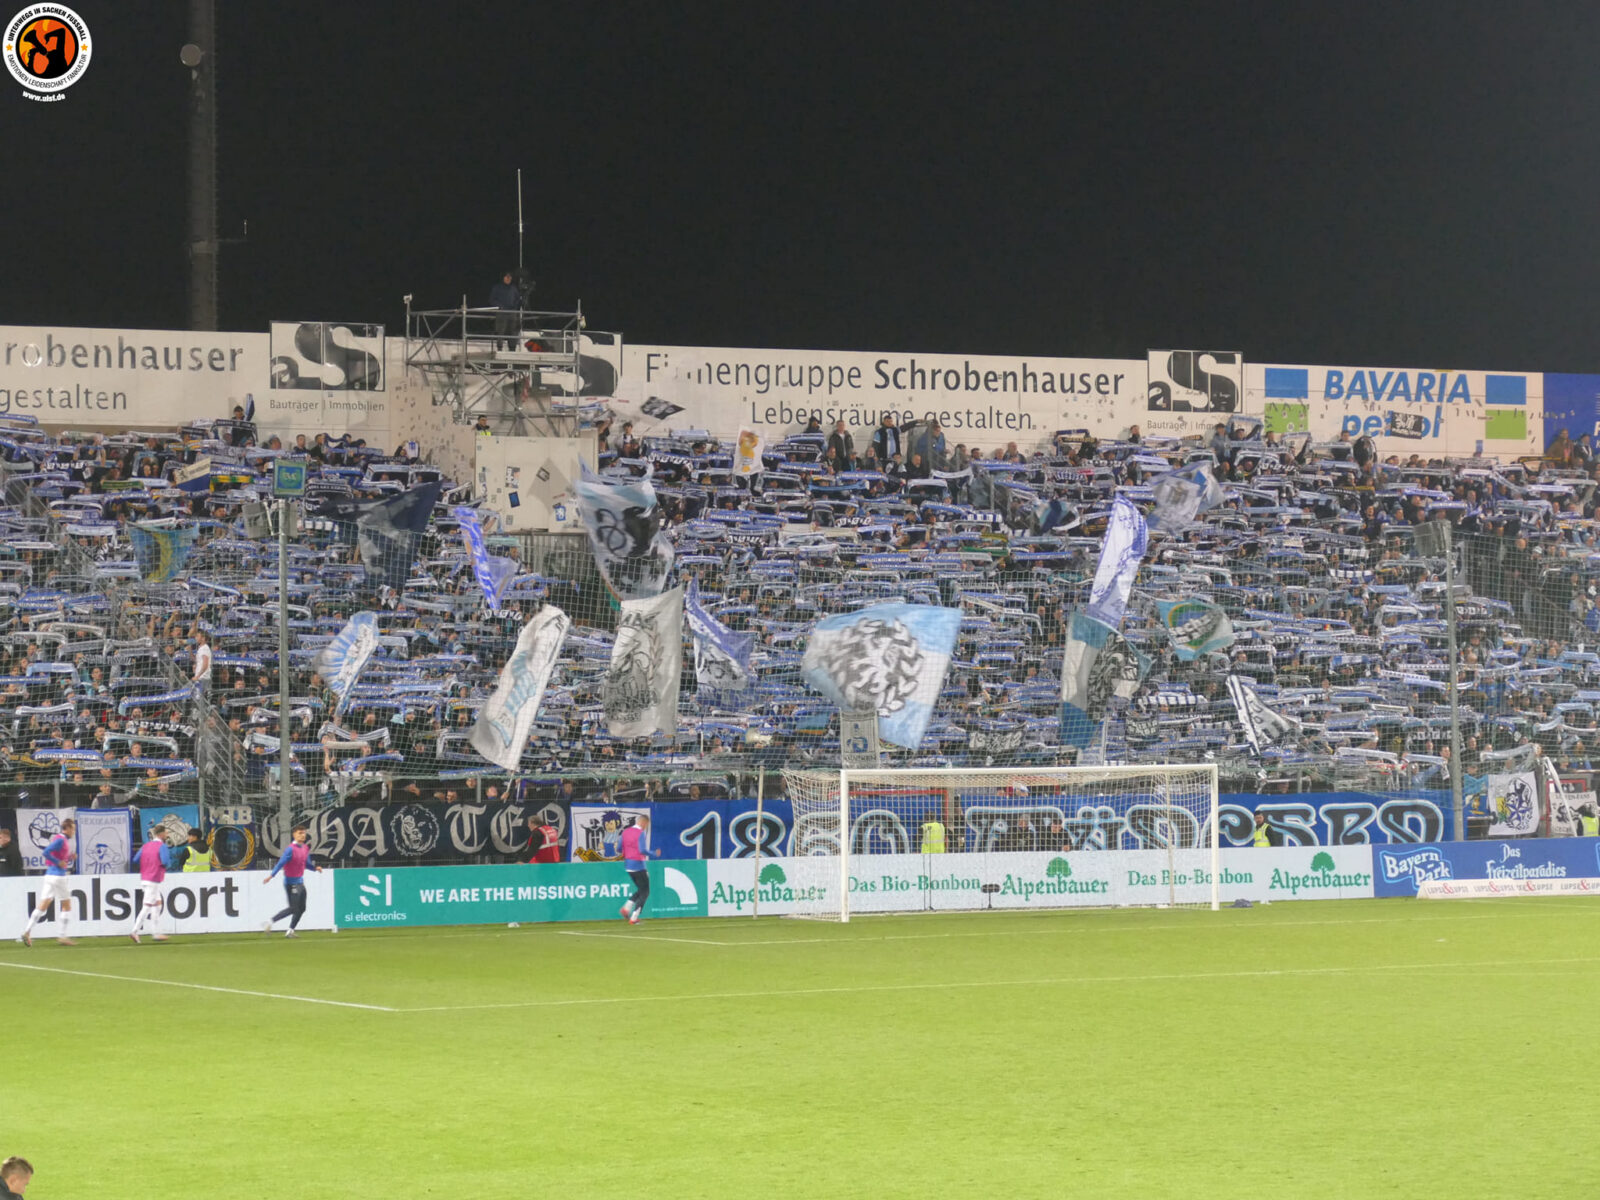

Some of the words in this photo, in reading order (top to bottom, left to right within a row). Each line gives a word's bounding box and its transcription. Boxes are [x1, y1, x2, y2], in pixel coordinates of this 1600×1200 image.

[5, 333, 243, 372] robenhauser
[874, 359, 1124, 395] Schrobenhauser
[1324, 370, 1471, 404] BAVARIA
[1500, 843, 1520, 863] Das
[882, 874, 981, 892] Bio-Bonbon
[1000, 874, 1108, 902] Alpenbauer
[1127, 870, 1156, 886] Das
[1269, 868, 1372, 895] Alpenbauer
[420, 889, 445, 903] WE
[448, 888, 480, 902] ARE
[484, 887, 514, 902] THE
[518, 885, 587, 900] MISSING
[590, 884, 633, 898] PART.
[344, 912, 353, 922] si
[356, 910, 407, 921] electronics
